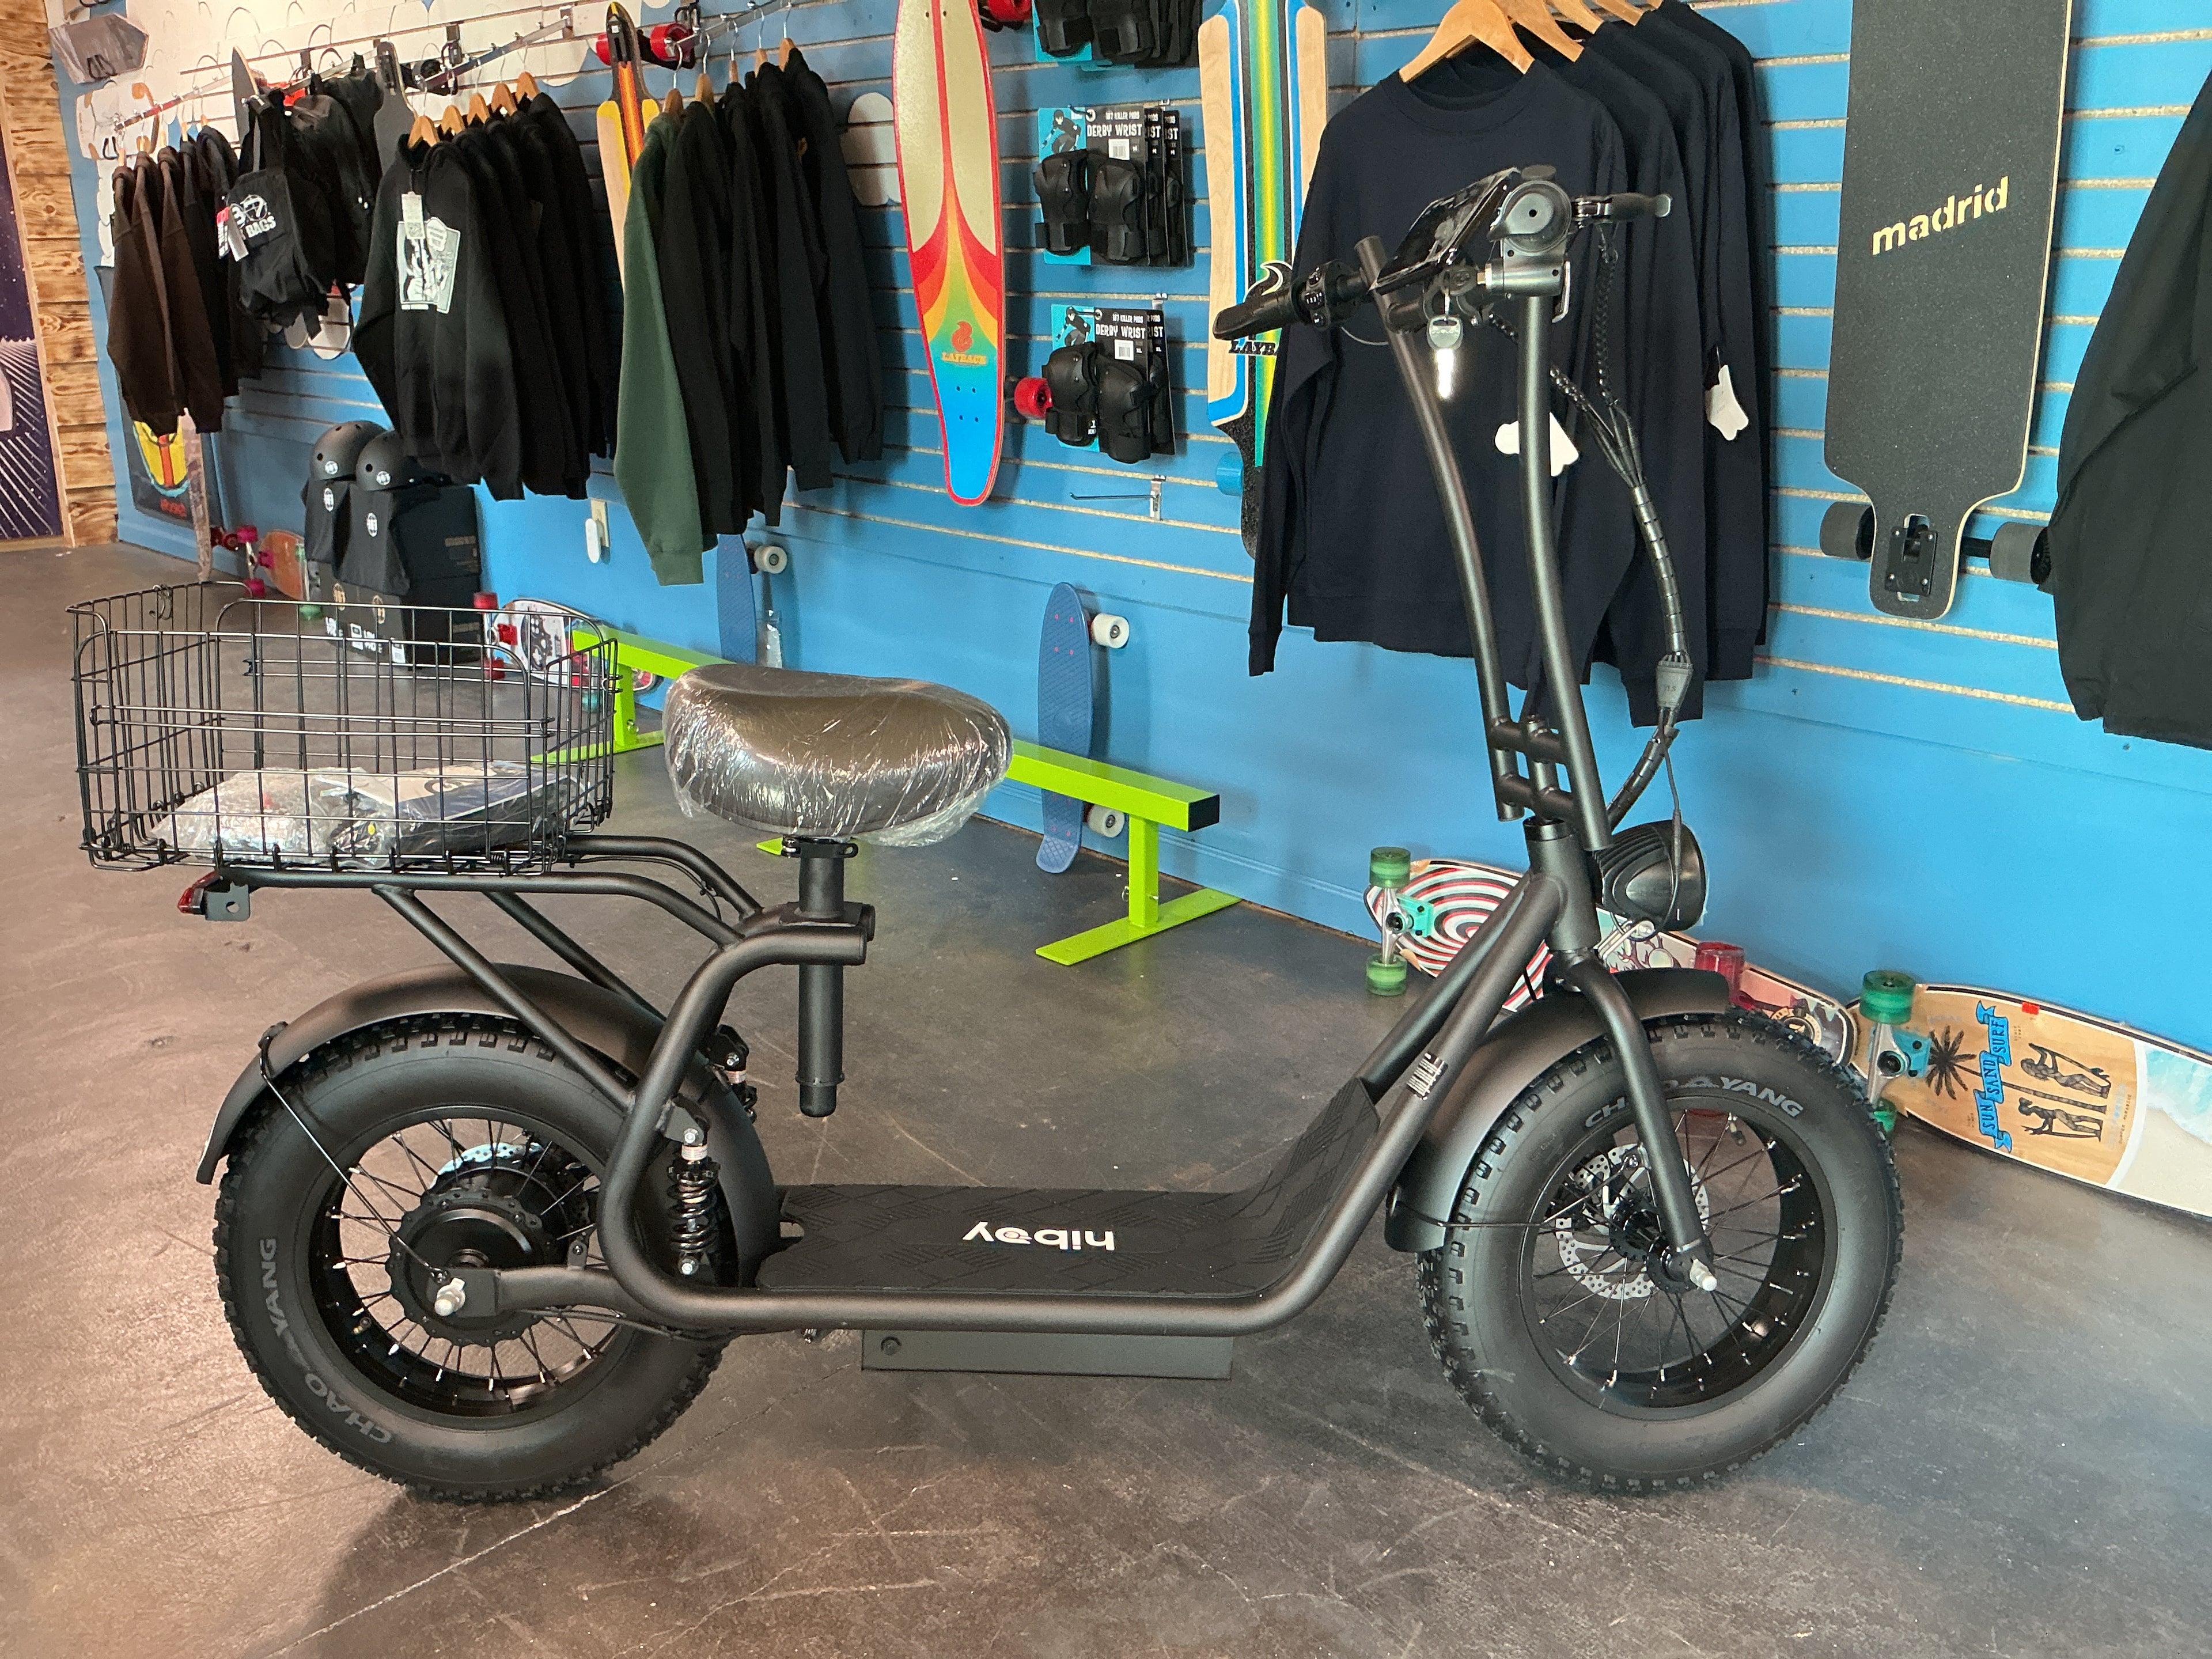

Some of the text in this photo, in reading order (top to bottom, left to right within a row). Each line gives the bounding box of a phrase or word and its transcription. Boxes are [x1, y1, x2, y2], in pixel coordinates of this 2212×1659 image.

[1087, 123, 1143, 138] DERBY WRIST
[245, 215, 276, 238] BAGS
[1872, 175, 2009, 255] madrid
[1096, 323, 1146, 339] DERBY WRIST
[1147, 325, 1164, 338] RIST
[1228, 340, 1278, 356] LAYB
[1979, 1018, 2007, 1130] SUN SAND SURF
[1720, 1076, 1805, 1118] YANG
[961, 1221, 1116, 1251] hiboy
[259, 1238, 394, 1444] CHAO YANG
